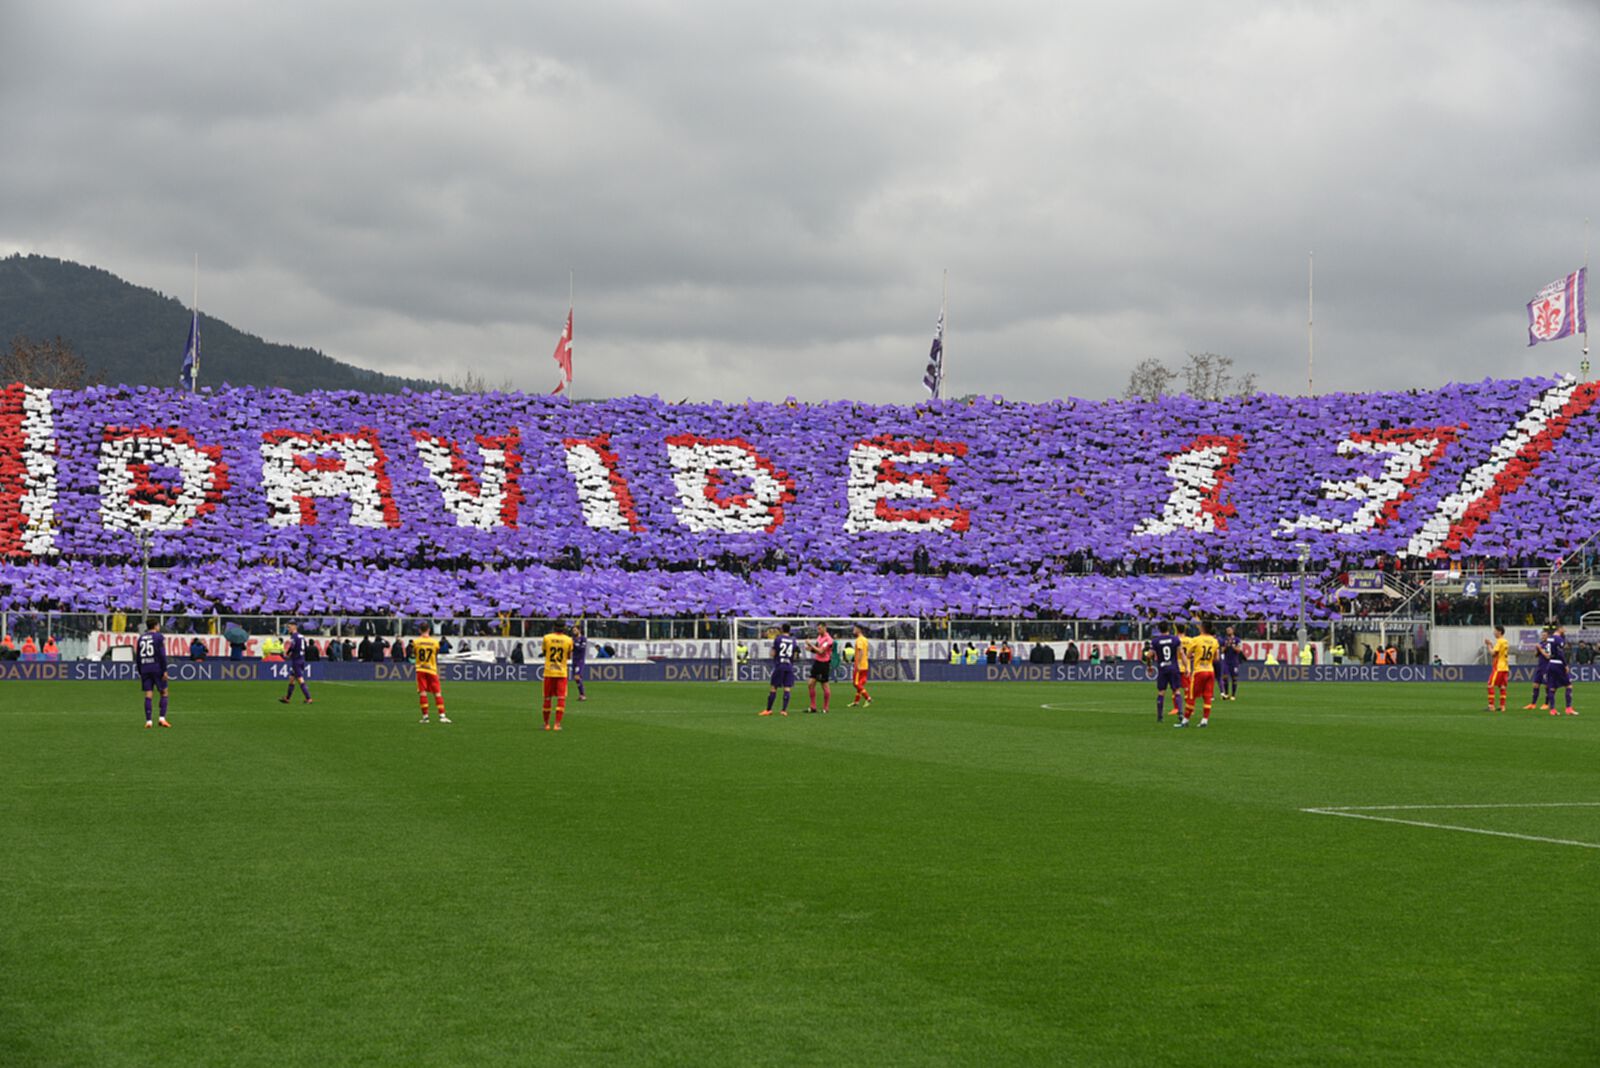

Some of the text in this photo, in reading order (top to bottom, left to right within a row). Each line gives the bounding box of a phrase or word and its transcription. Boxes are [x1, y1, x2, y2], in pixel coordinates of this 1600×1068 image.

[100, 424, 970, 534] DAVIDE
[139, 640, 155, 657] 25
[418, 648, 433, 663] 87
[550, 646, 564, 663] 23
[779, 643, 793, 658] 24
[1162, 645, 1172, 661] 9
[1200, 645, 1213, 661] 16
[75, 663, 141, 680] SEMPR
[166, 663, 213, 680] CON
[221, 664, 257, 679] NOI
[375, 664, 447, 681] DAVE
[452, 664, 528, 681] SEMPRE
[590, 665, 624, 681] NOI
[987, 665, 1159, 681] DAVIDE SEMPRE CO
[1248, 666, 1464, 681] DAVIDE SEMPRE CON NOI
